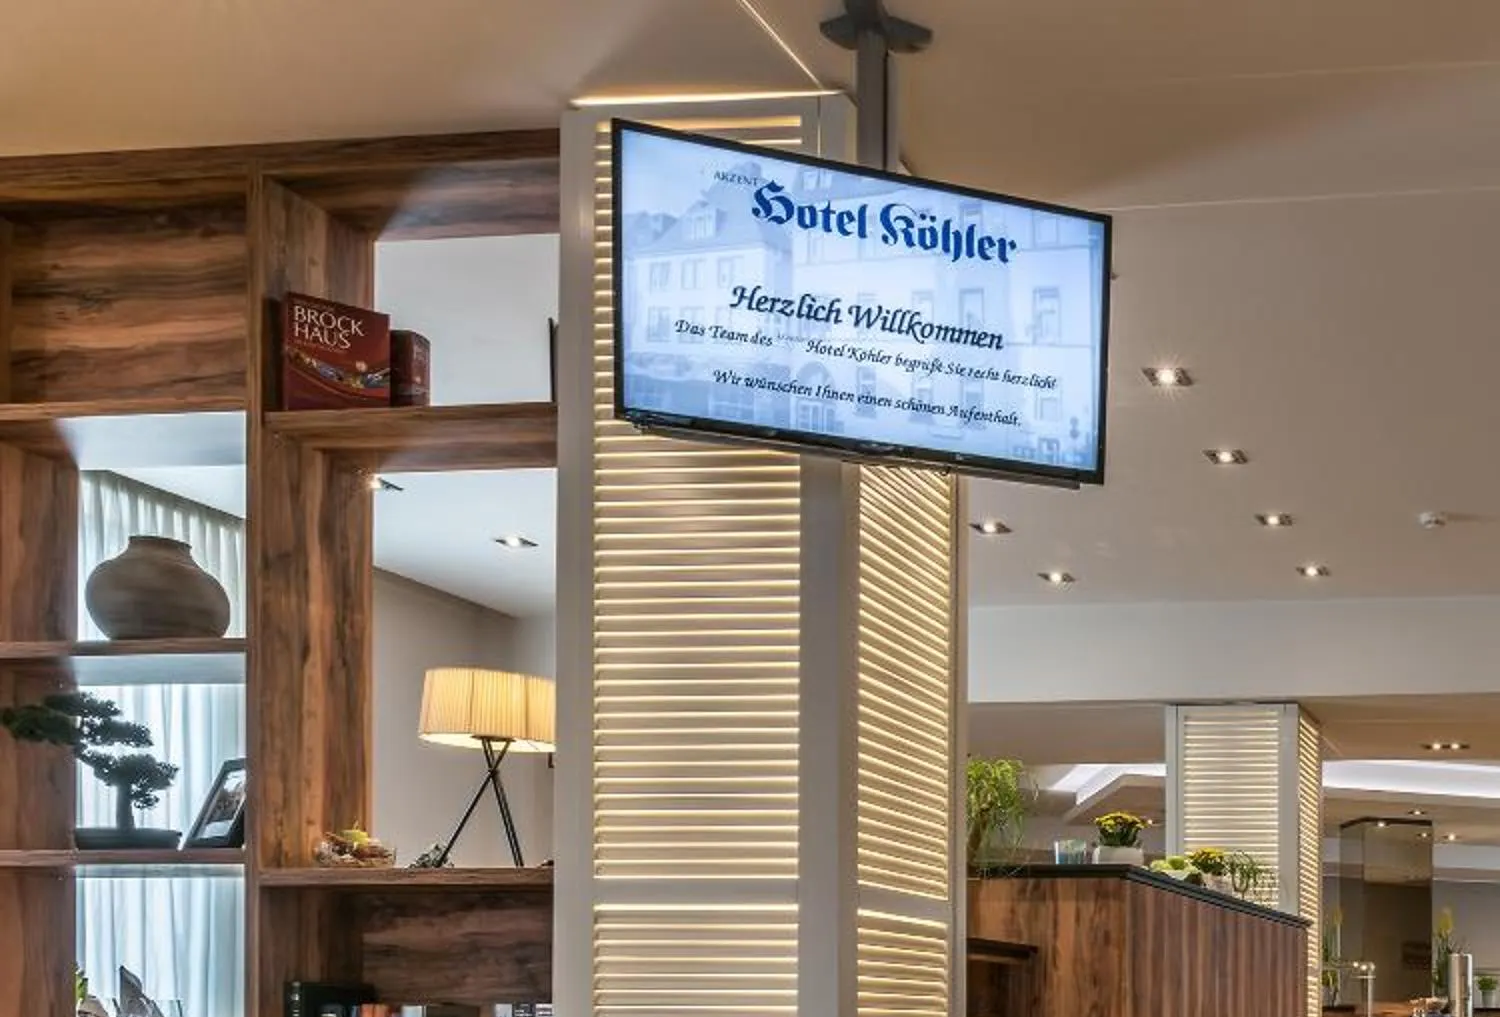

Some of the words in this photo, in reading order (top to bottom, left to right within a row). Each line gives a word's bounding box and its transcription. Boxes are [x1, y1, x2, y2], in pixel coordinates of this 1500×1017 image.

[713, 170, 759, 186] AKZENT
[752, 180, 868, 239] Hotel
[879, 203, 1017, 264] Köhler
[293, 305, 365, 337] BROCK
[293, 322, 352, 349] HAUS
[729, 284, 843, 325] Herzlich
[848, 305, 1004, 350] Willkommen
[674, 318, 706, 337] Das
[708, 325, 749, 344] Team
[750, 331, 773, 347] des
[805, 338, 848, 358] Hotel
[945, 360, 966, 378] Sie
[967, 366, 1000, 381] recht
[713, 370, 742, 388] Wir
[743, 375, 813, 397] wünschen
[815, 384, 855, 403] Ihnen
[857, 391, 892, 407] einen
[894, 397, 945, 415] schönen
